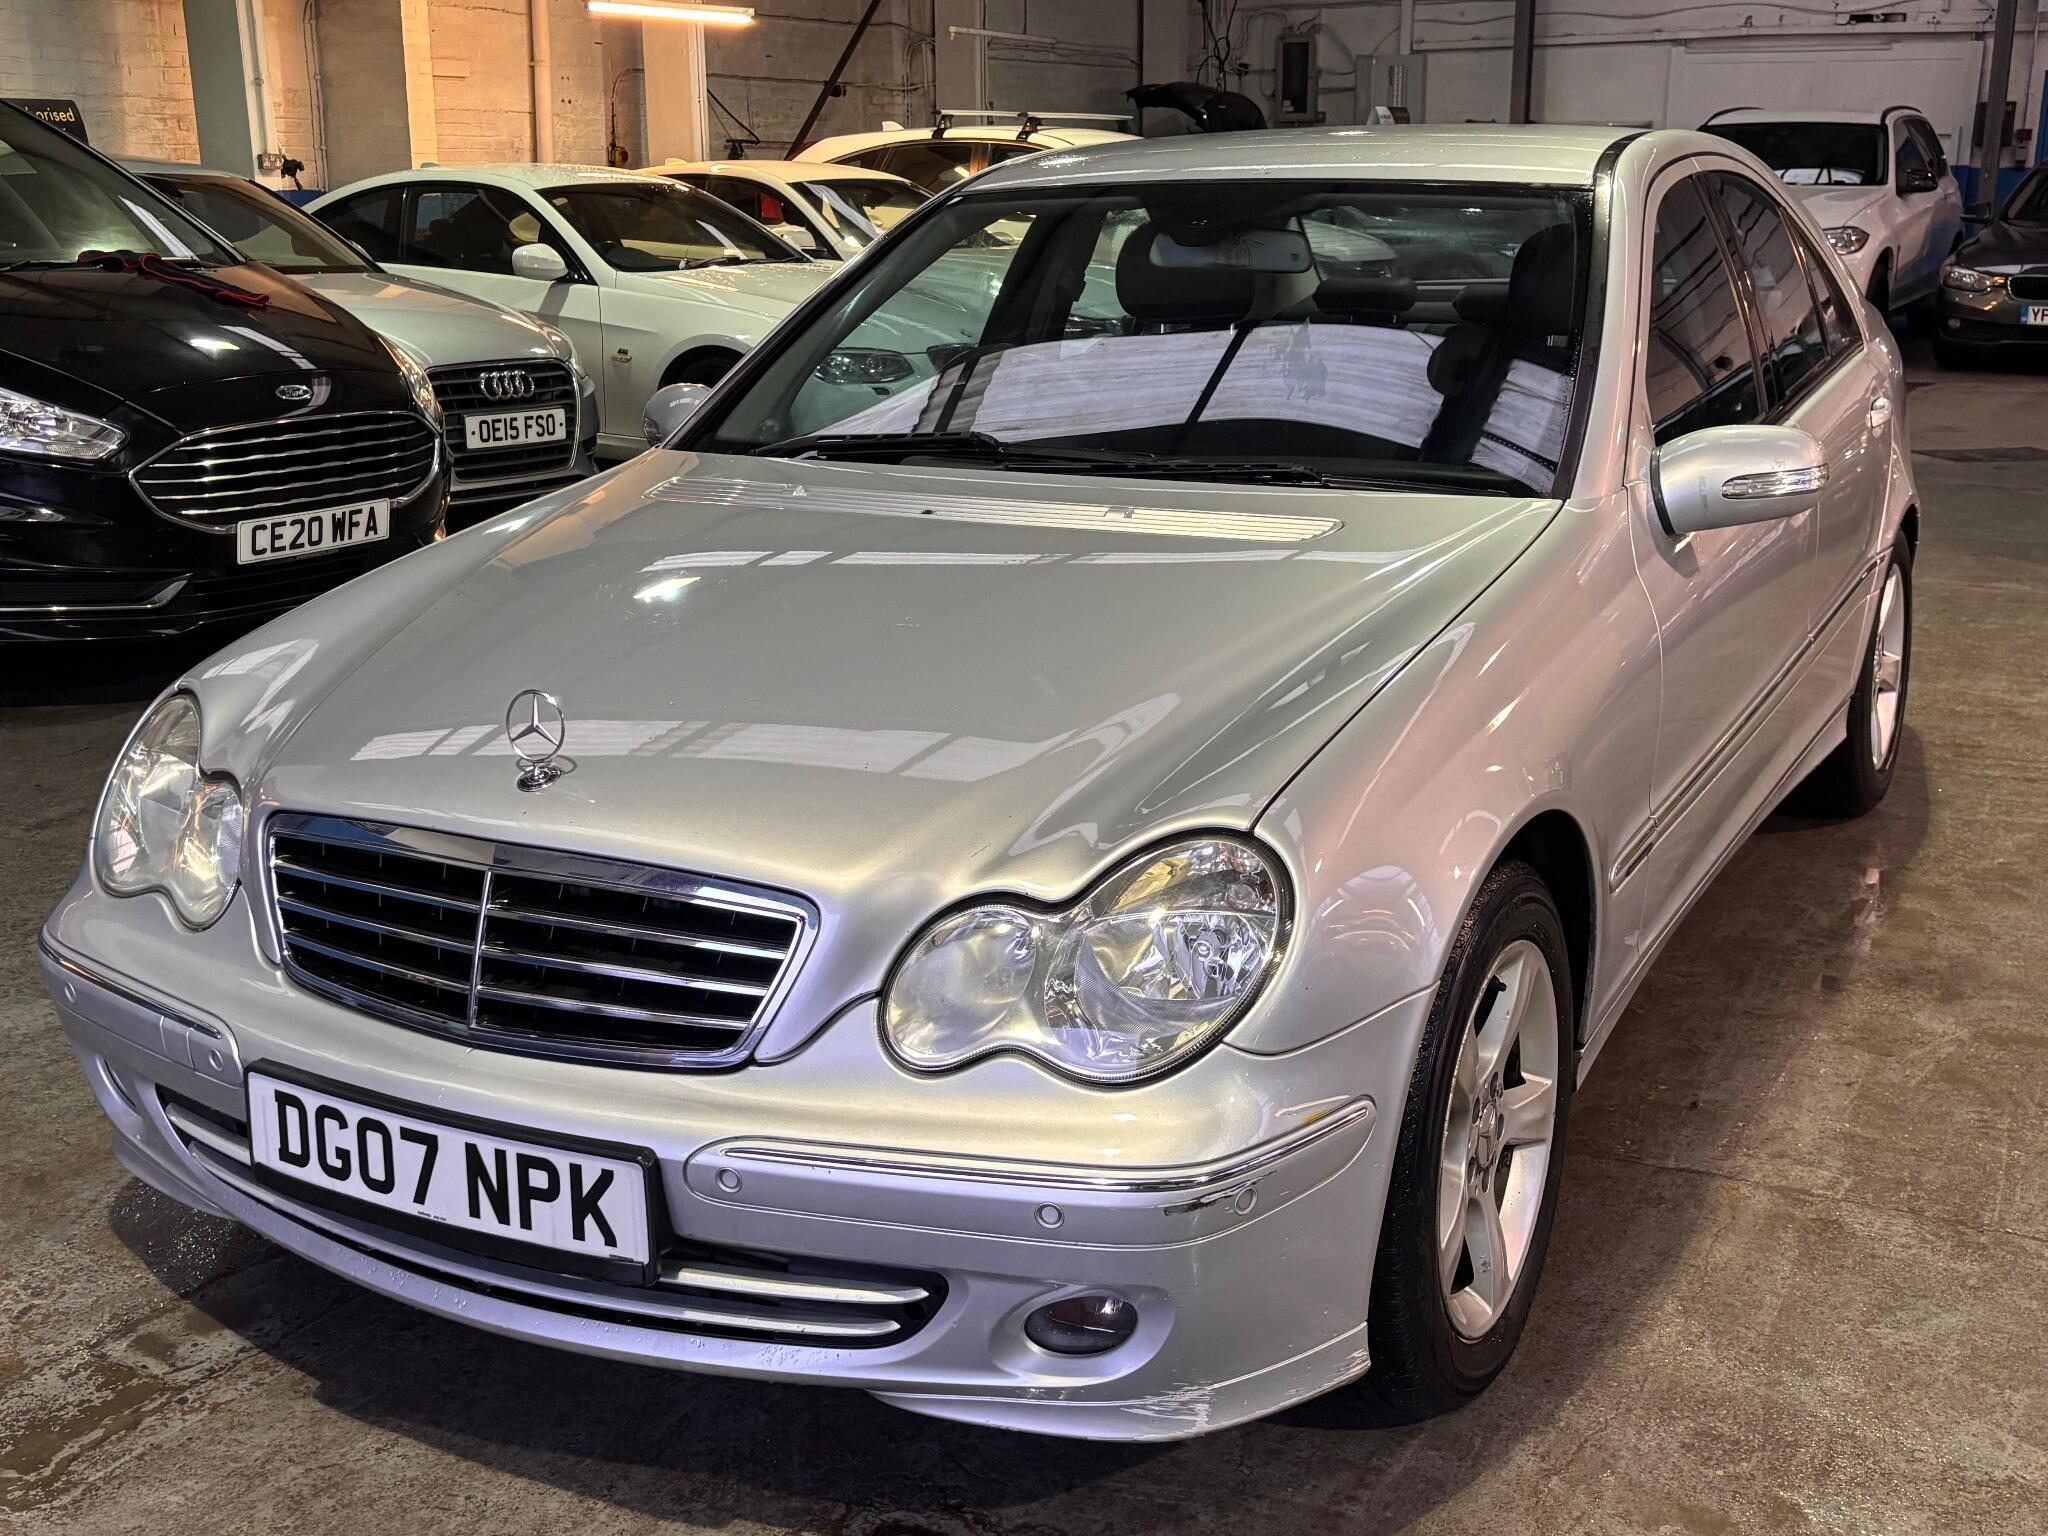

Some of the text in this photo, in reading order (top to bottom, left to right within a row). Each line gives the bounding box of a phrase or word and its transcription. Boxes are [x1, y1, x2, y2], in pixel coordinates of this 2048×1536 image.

[478, 413, 556, 443] OE15 FSO
[251, 506, 378, 556] CE20 WFA
[274, 1088, 618, 1248] DG07 NPK
